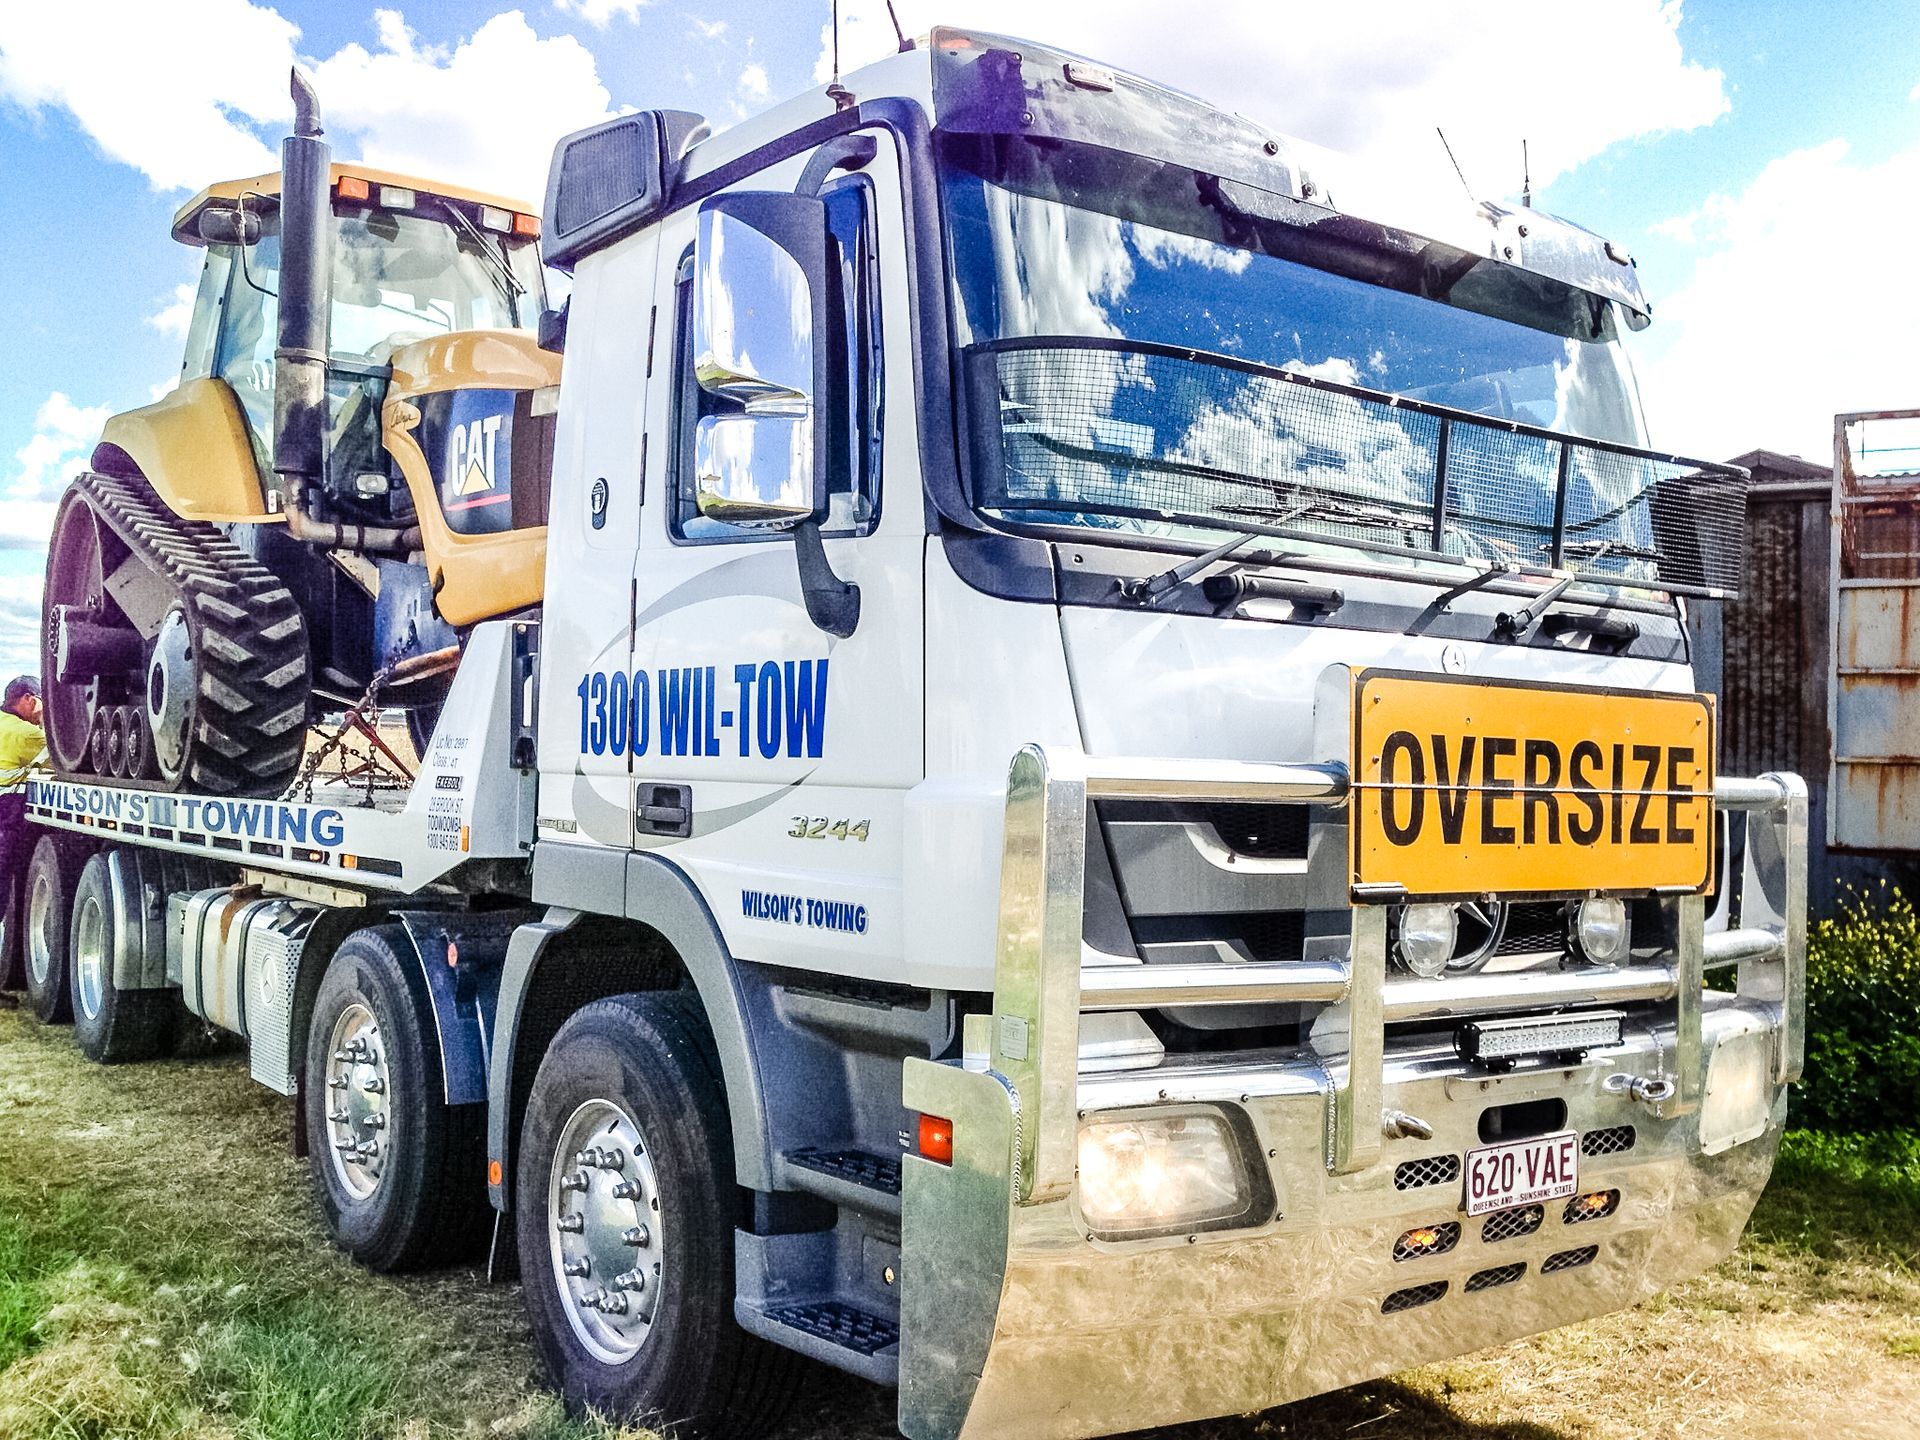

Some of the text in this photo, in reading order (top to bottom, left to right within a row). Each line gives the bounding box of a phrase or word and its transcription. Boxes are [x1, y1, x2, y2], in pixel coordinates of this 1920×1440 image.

[452, 415, 503, 496] CAT
[578, 659, 829, 758] 1300 WIL-TOW
[39, 782, 344, 846] WILSON'S TOWING
[1380, 731, 1695, 846] OVERSIZE
[788, 815, 871, 842] 3244
[741, 889, 868, 933] WILSON'S TOWING
[1473, 1195, 1514, 1212] QUEENSLAND
[1520, 1189, 1552, 1202] SUNSHINE
[1554, 1184, 1573, 1195] STATE
